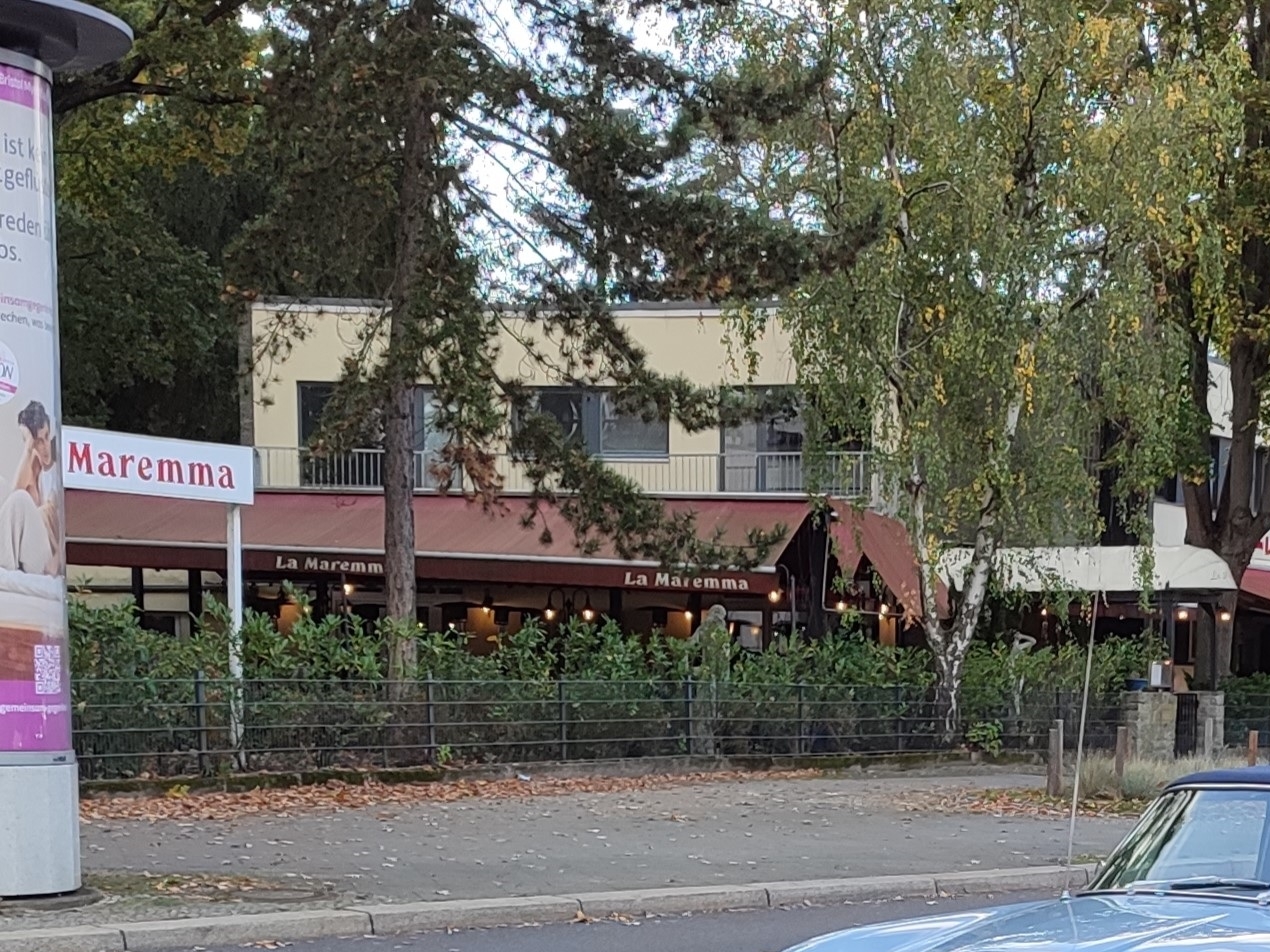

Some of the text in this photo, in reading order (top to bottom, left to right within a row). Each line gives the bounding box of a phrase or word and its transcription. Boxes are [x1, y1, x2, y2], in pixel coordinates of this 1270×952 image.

[4, 132, 24, 158] ist
[68, 441, 236, 489] Maremma
[276, 555, 384, 574] La Maremm
[624, 572, 749, 591] La Maremma
